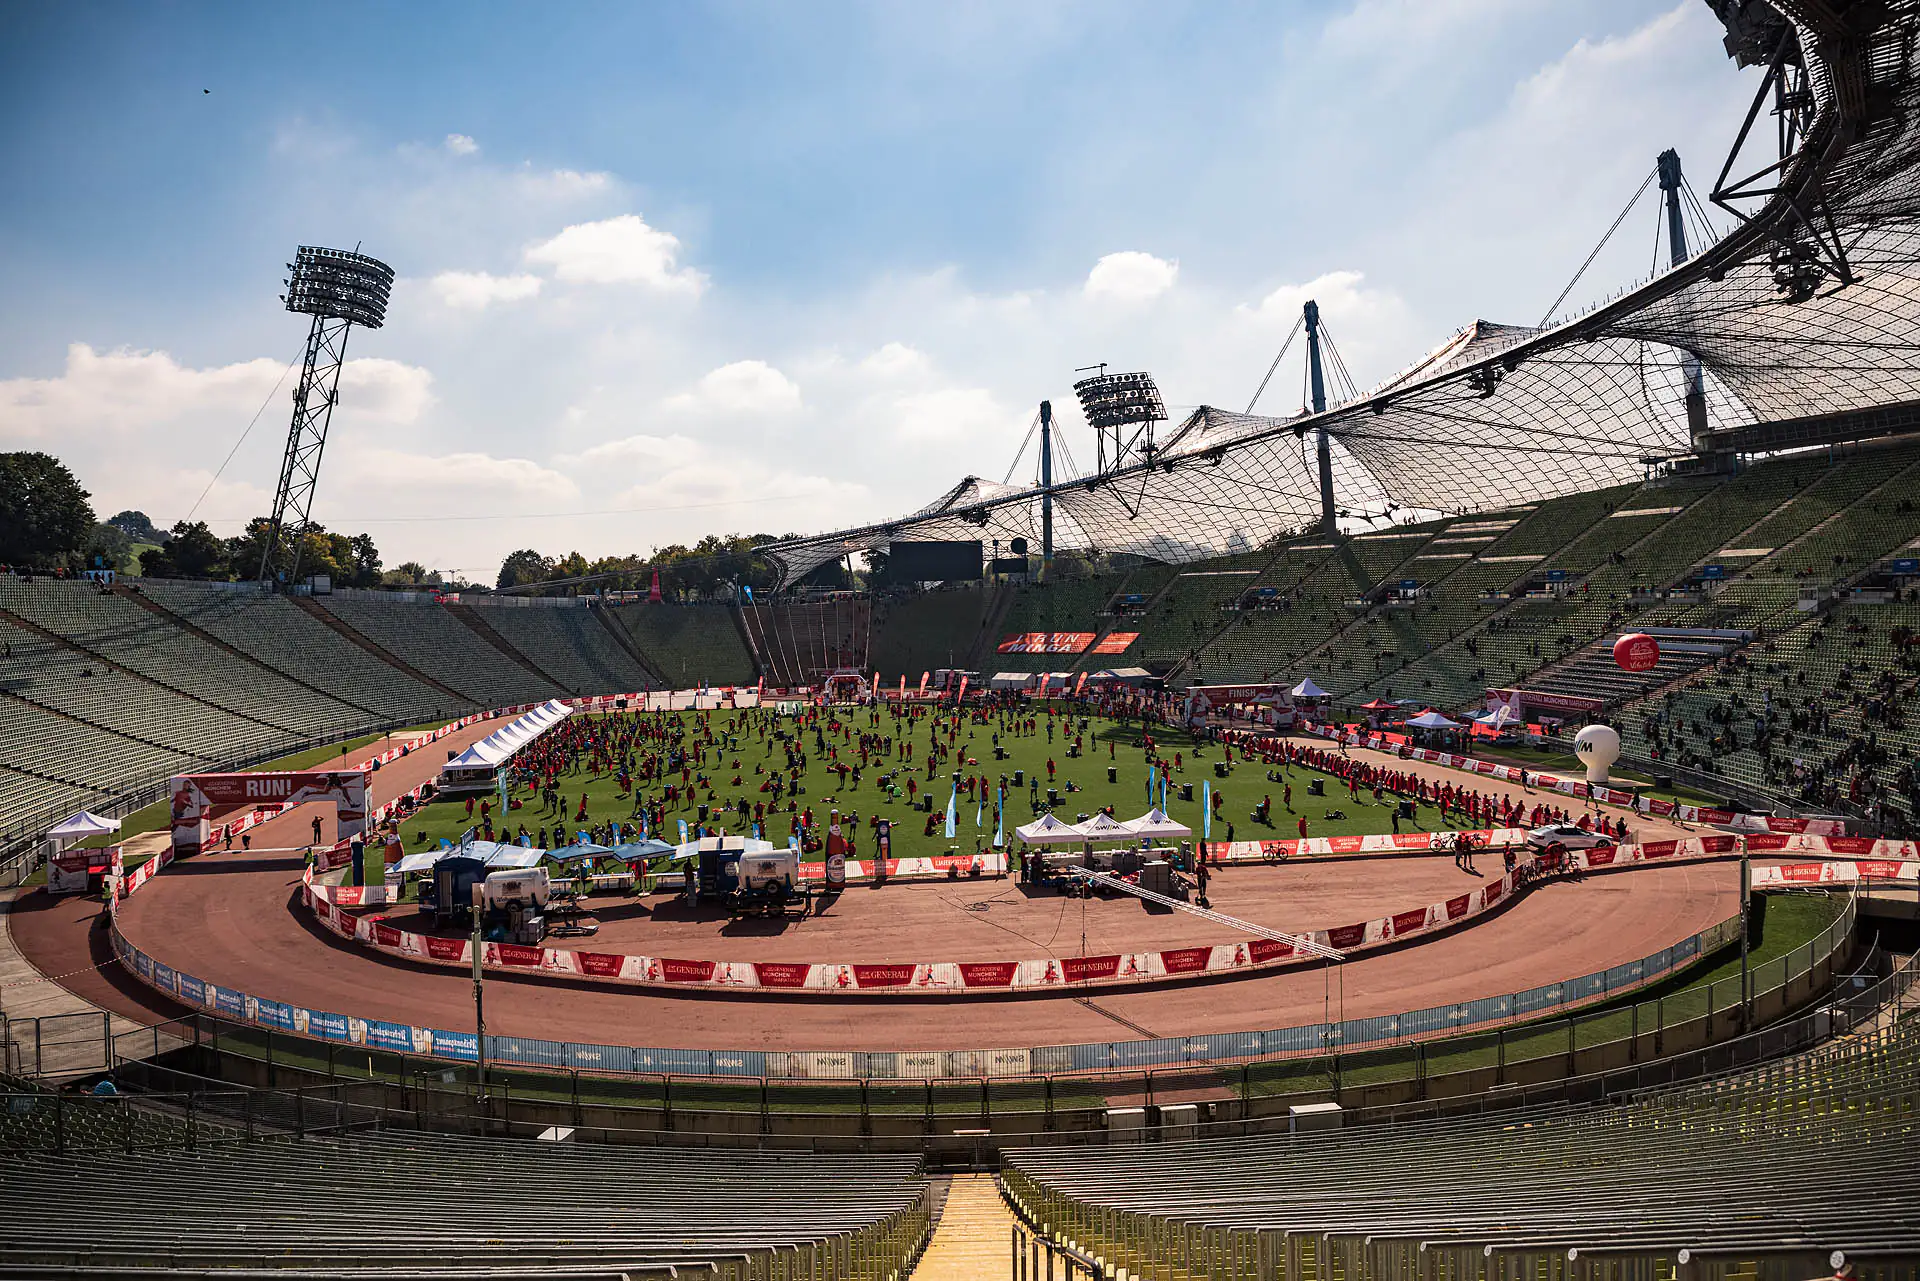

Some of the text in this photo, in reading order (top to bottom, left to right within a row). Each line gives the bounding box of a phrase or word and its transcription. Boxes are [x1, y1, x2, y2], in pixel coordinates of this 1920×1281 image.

[1034, 634, 1080, 643] RUN
[1008, 643, 1072, 652] MINGA
[1228, 688, 1256, 698] FINISH
[246, 779, 292, 797] RUN!
[676, 965, 710, 976] GENERALI
[1077, 962, 1115, 972] GENERALI
[870, 970, 909, 980] GENERALI
